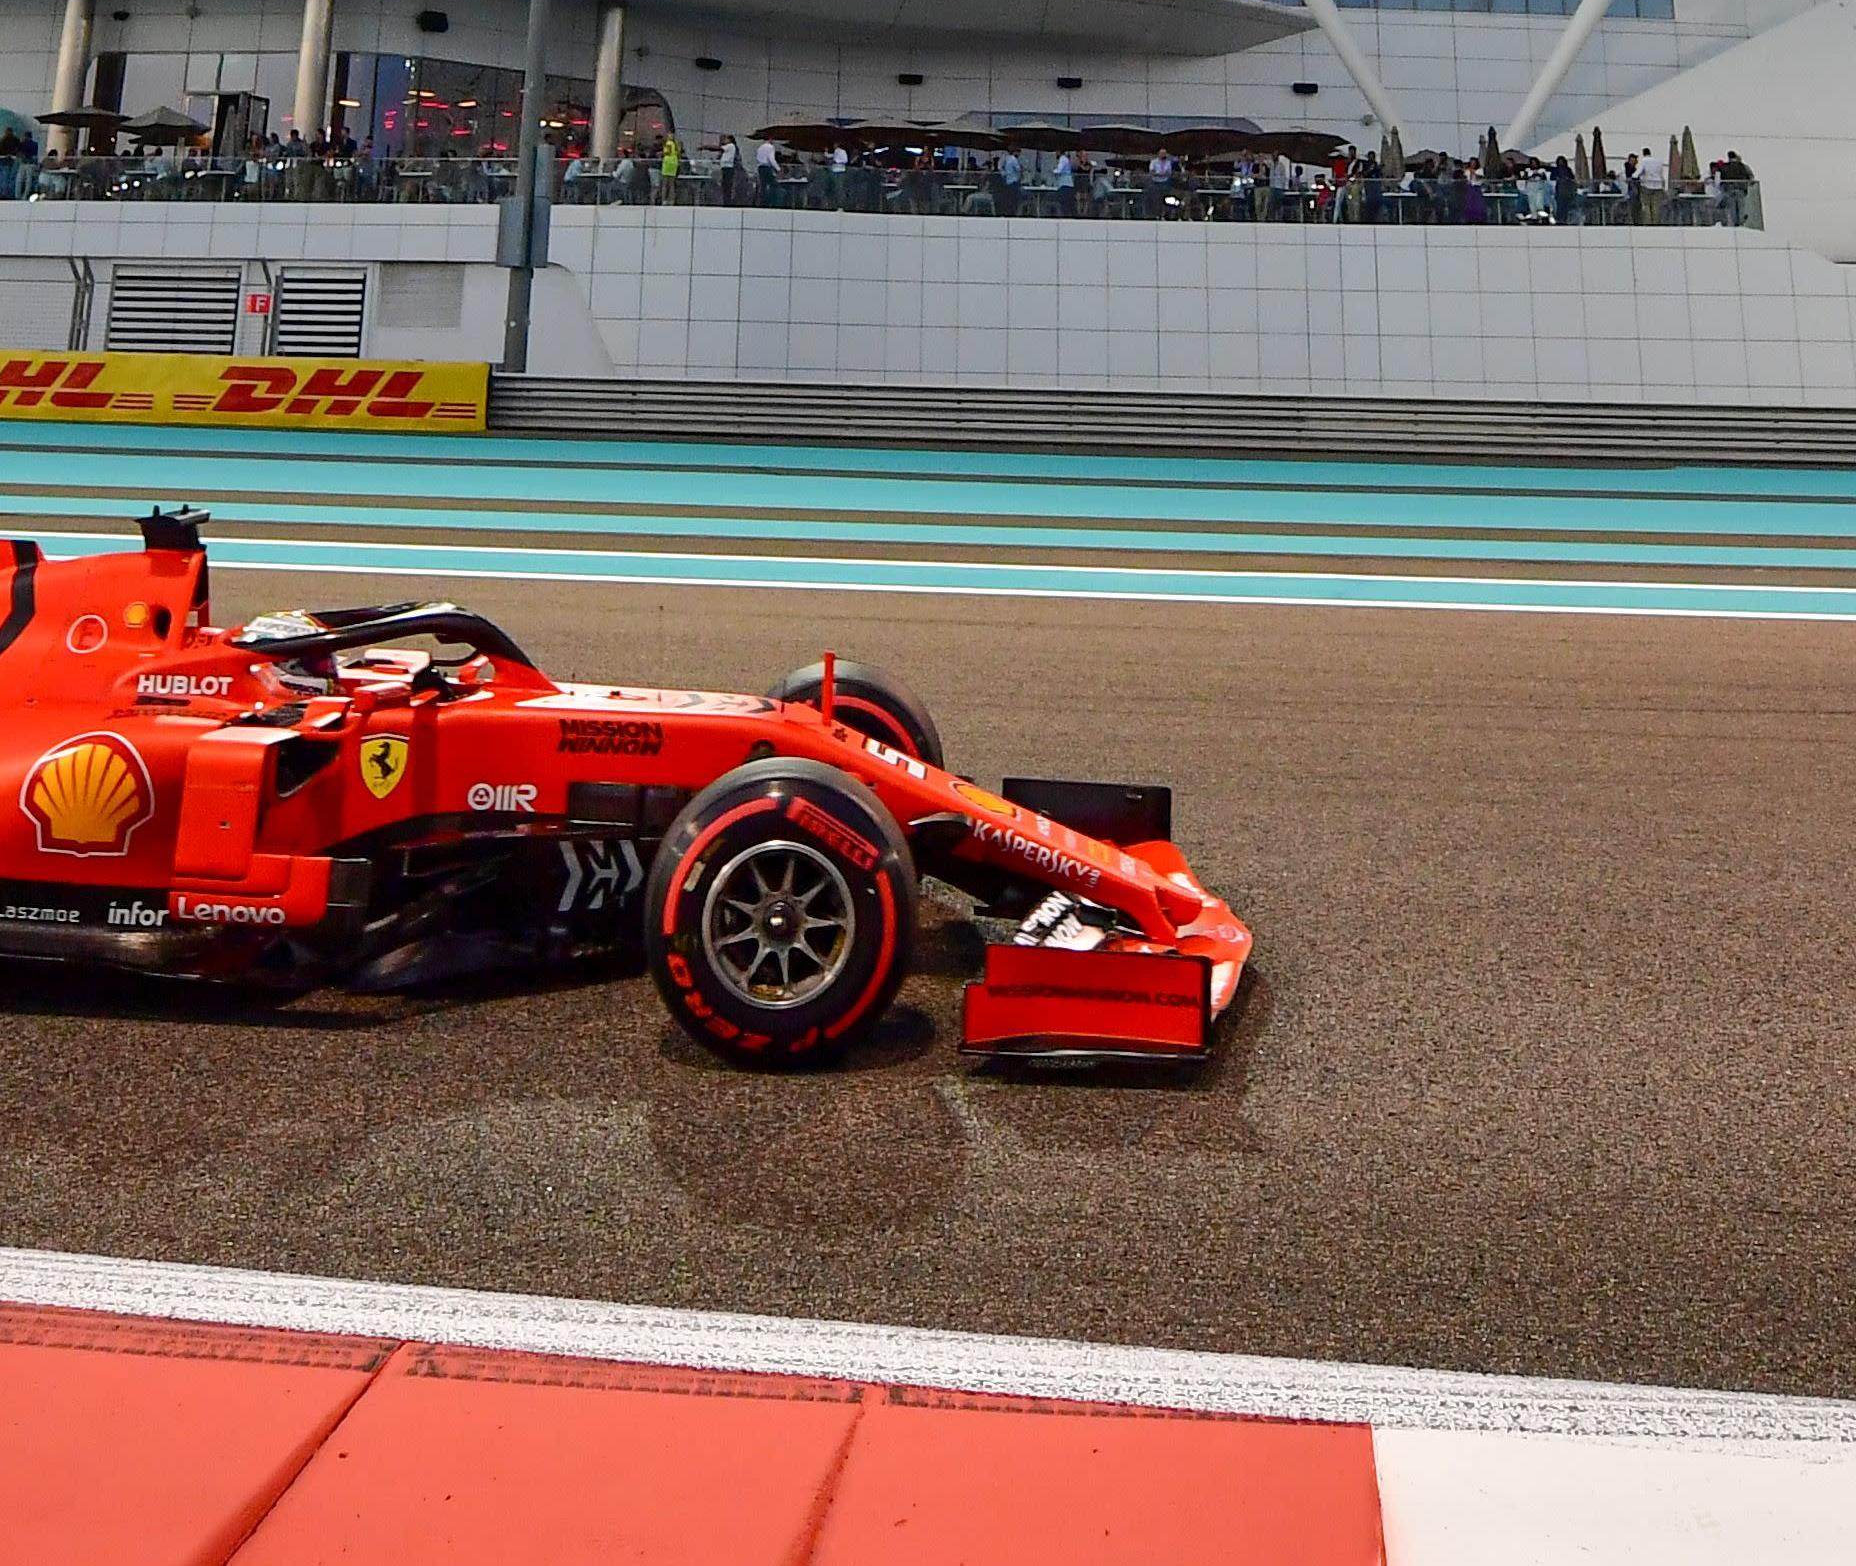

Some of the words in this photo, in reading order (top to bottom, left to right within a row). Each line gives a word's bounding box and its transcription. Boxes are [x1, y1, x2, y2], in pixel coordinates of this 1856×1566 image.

[211, 366, 435, 418] DHL
[136, 674, 234, 696] HUBLOT
[107, 901, 170, 927] infor
[178, 896, 286, 925] Lenovo
